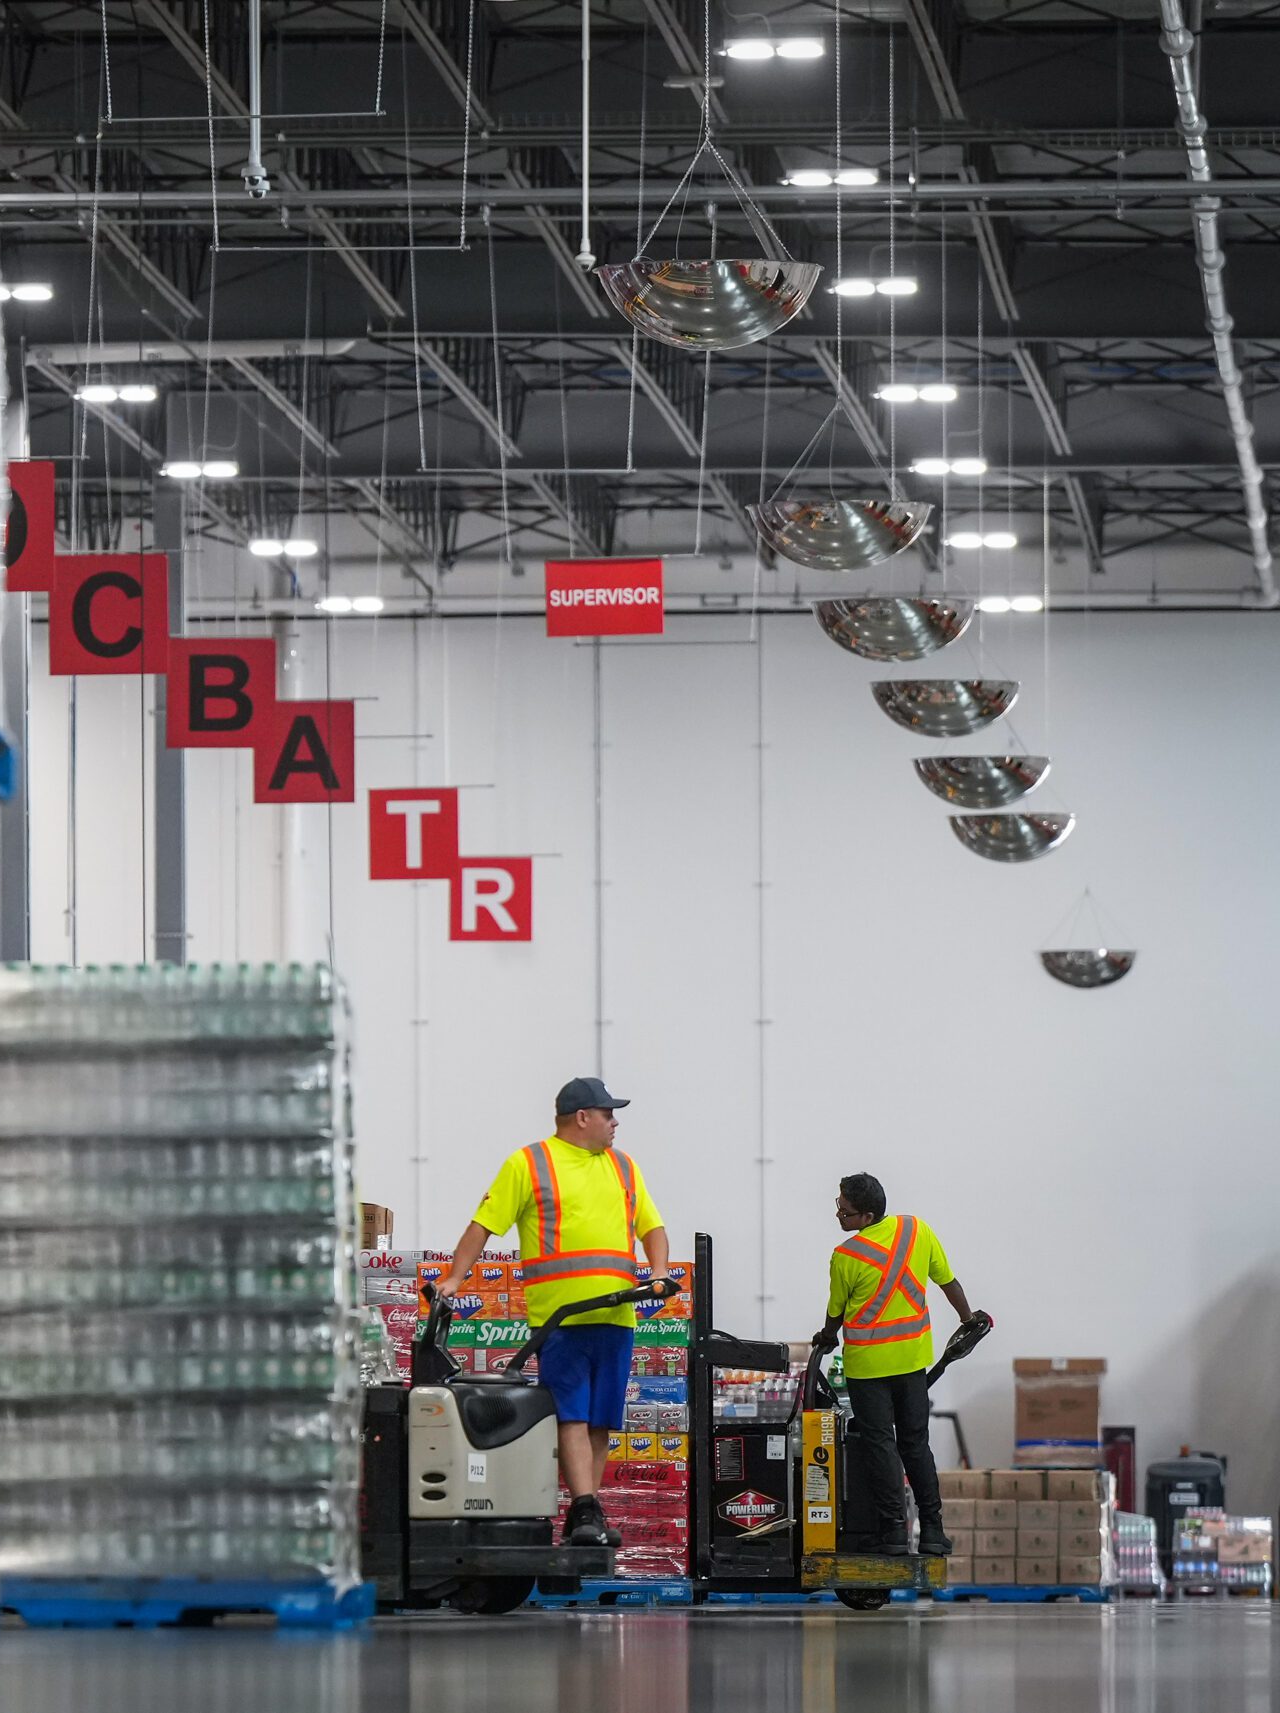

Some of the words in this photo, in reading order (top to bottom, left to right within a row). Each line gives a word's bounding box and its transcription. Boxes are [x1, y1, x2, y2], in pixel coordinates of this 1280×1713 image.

[549, 586, 660, 608] SUPERVISOR
[71, 570, 144, 659] C
[188, 653, 254, 732] B
[268, 715, 340, 790] A
[386, 800, 440, 869] T
[461, 867, 519, 933] R
[360, 1251, 403, 1268] Coke
[425, 1250, 453, 1262] Coke
[484, 1250, 512, 1262] Coke
[421, 1267, 442, 1277] FANTA
[482, 1268, 503, 1277] FANTA
[668, 1267, 686, 1276] ANTA
[634, 1298, 665, 1309] ANTA
[633, 1322, 658, 1333] prite
[657, 1320, 687, 1335] Sprite
[608, 1438, 621, 1446] NTA
[630, 1437, 652, 1446] FANTA
[661, 1437, 682, 1446] FANTA
[726, 1503, 776, 1516] POWERLINE
